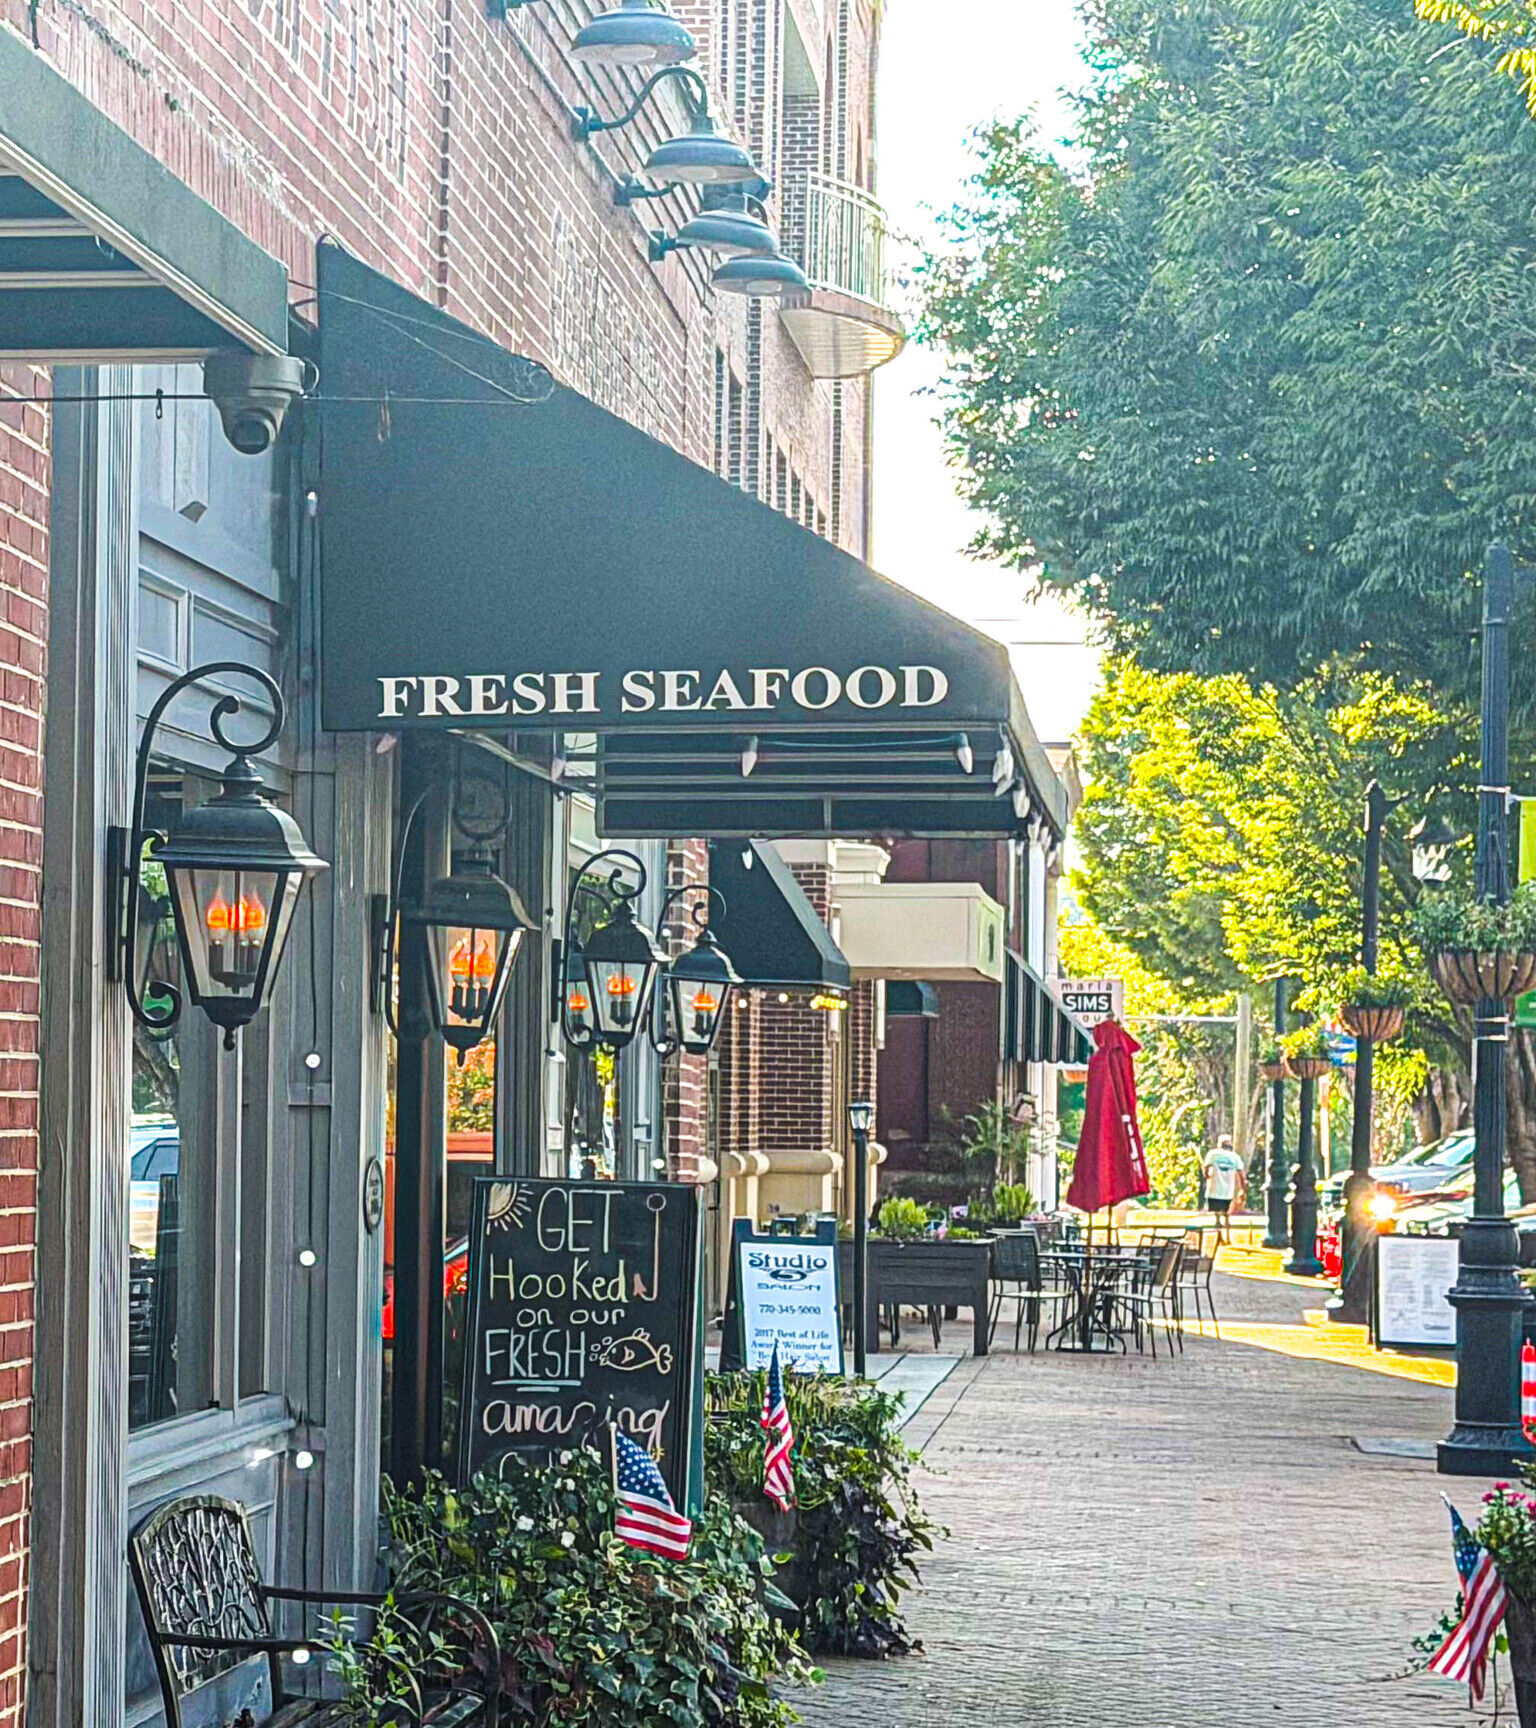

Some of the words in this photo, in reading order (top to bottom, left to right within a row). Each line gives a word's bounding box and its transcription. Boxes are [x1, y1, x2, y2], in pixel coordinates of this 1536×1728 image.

[377, 671, 601, 718] FRESH
[621, 665, 949, 713] SEAFOOD
[1066, 995, 1109, 1011] SIMS
[537, 1187, 625, 1254] GET
[748, 1252, 828, 1269] Studio
[517, 1308, 554, 1328] on
[569, 1308, 625, 1325] our
[777, 1329, 796, 1338] Best
[799, 1330, 808, 1339] of
[485, 1327, 586, 1379] FRESH
